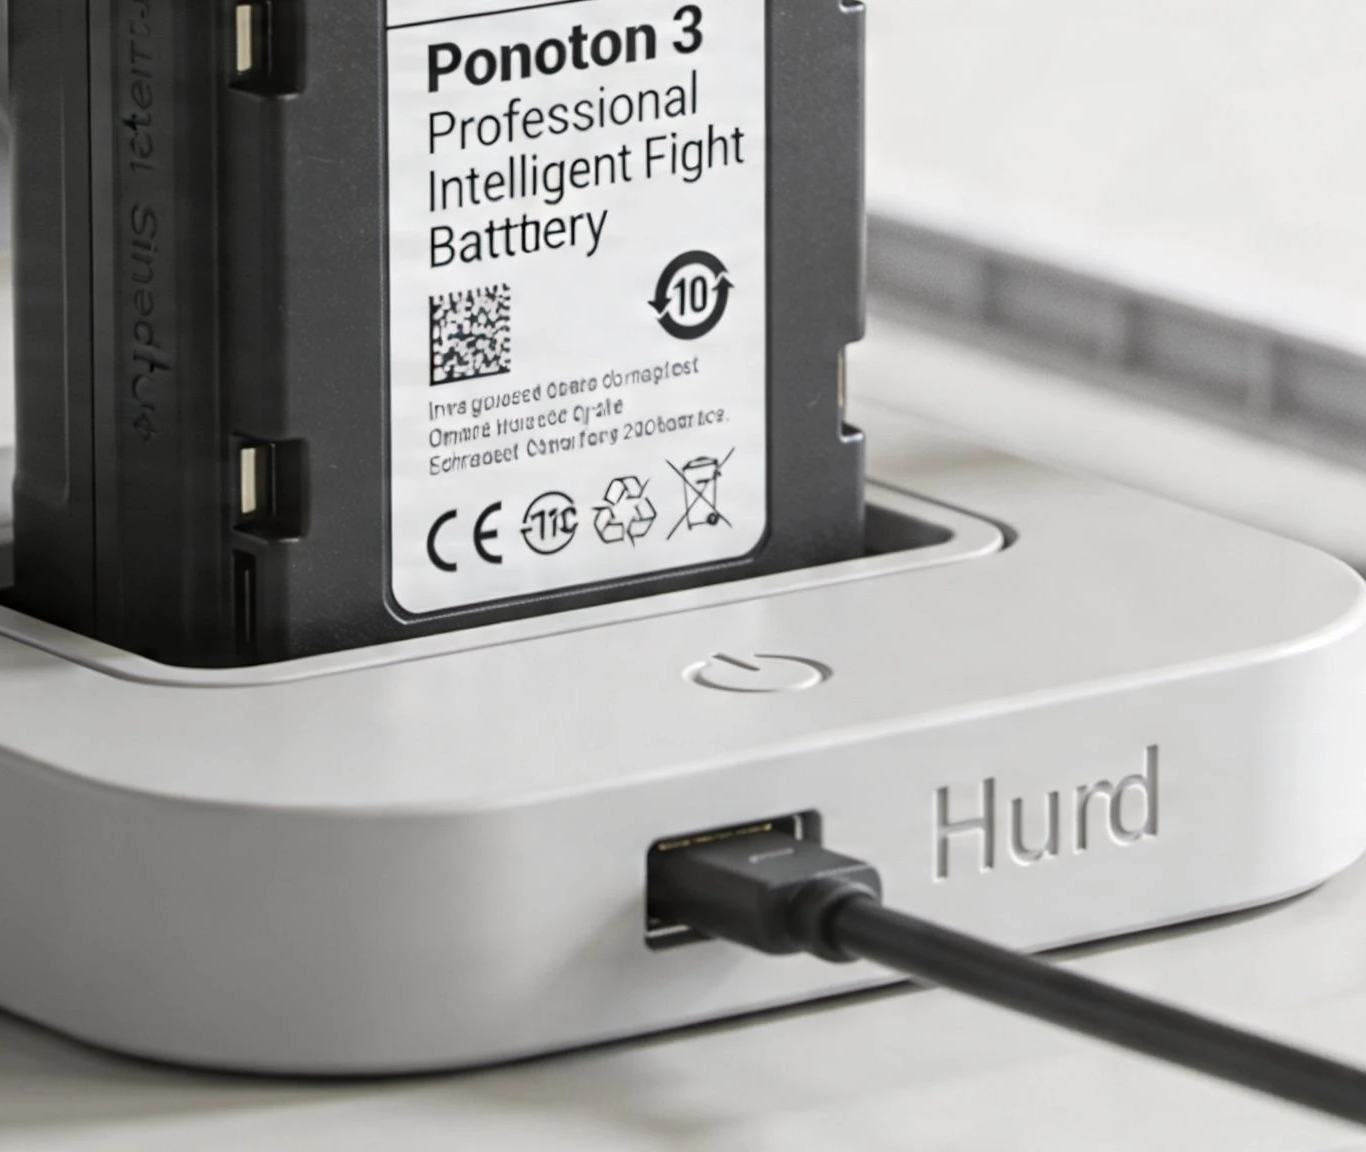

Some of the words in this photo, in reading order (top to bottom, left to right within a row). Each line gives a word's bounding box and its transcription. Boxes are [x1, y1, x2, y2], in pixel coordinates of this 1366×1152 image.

[427, 23, 657, 93] Ponoton
[672, 4, 704, 54] 3
[429, 69, 698, 155] Professional
[429, 144, 632, 212] Intelligent
[645, 124, 745, 183] Fight
[673, 275, 708, 316] 10
[934, 744, 1160, 882] Hurd
